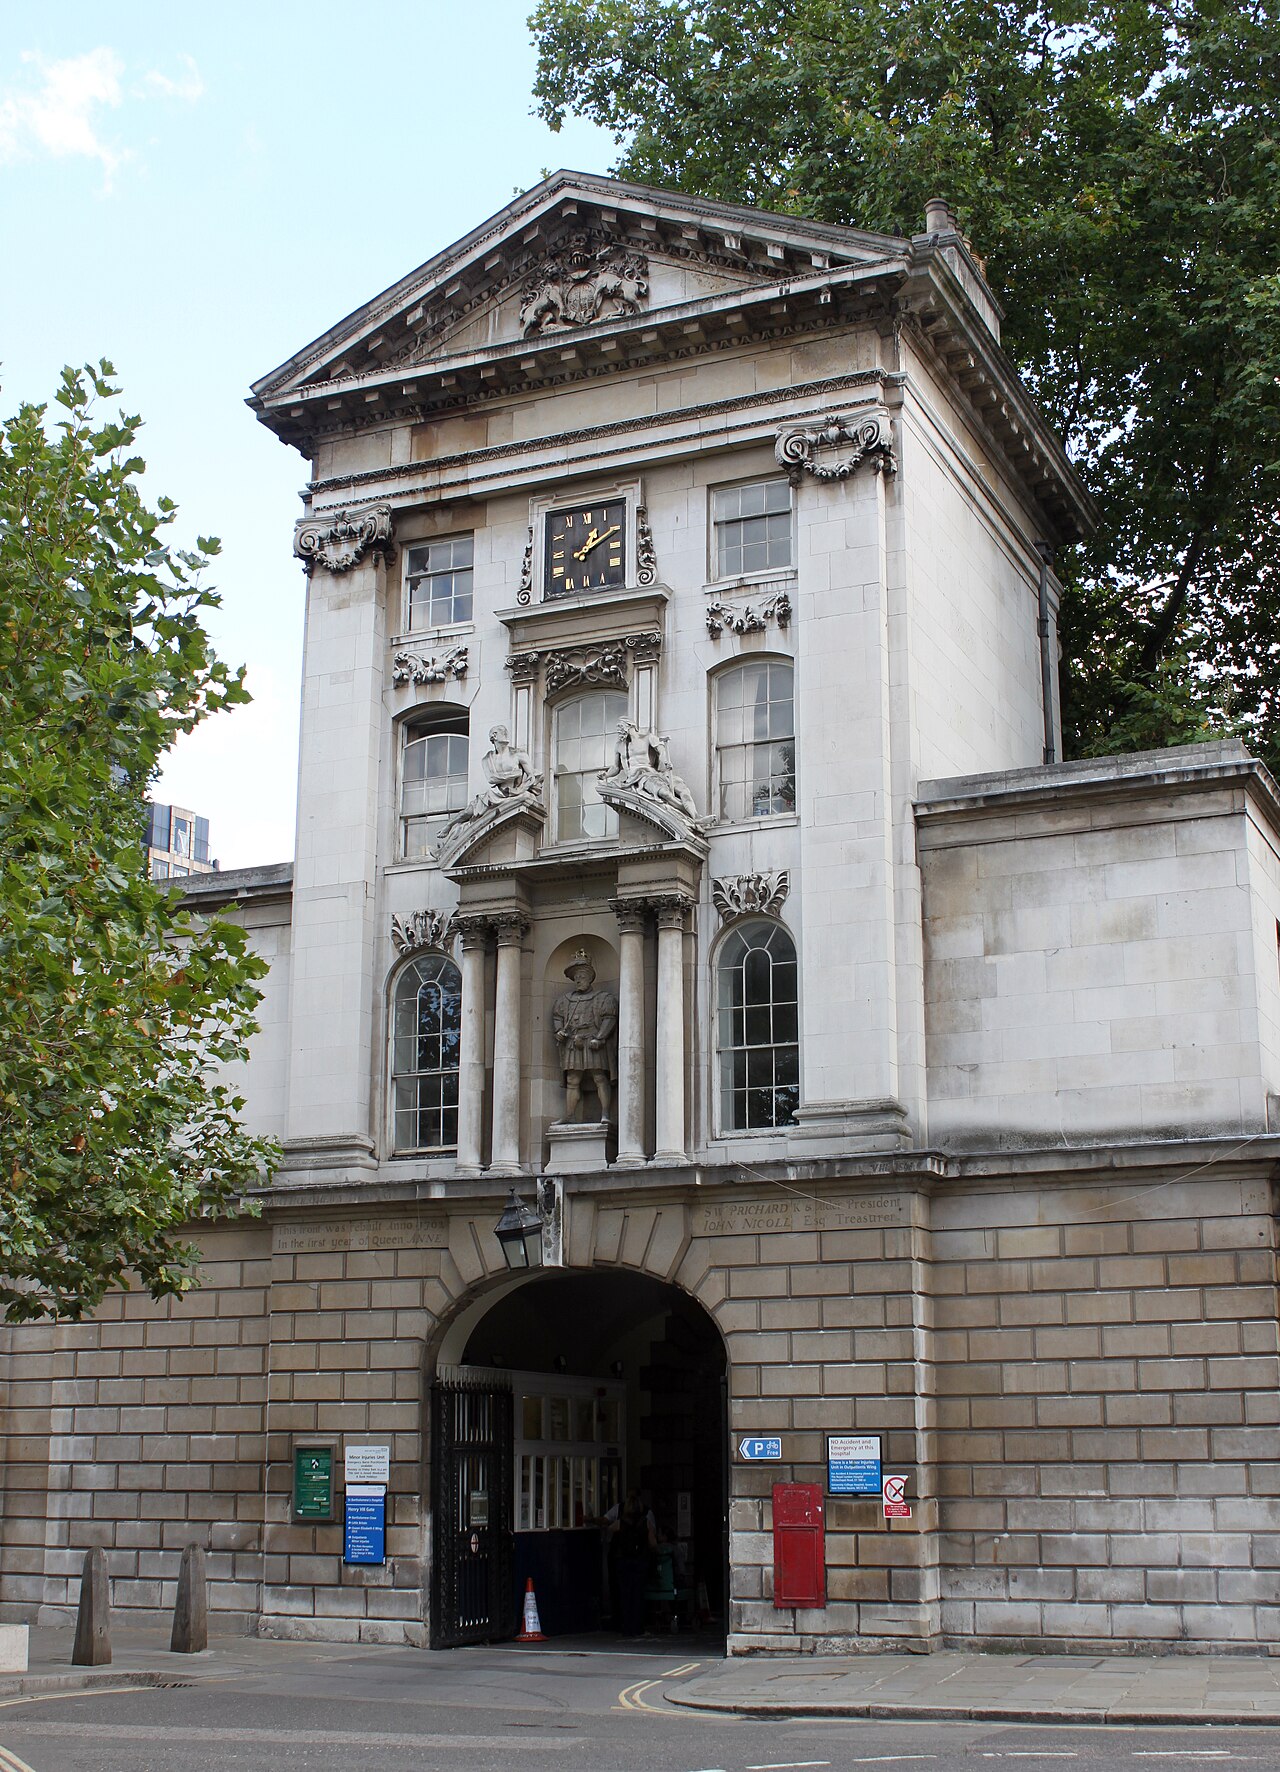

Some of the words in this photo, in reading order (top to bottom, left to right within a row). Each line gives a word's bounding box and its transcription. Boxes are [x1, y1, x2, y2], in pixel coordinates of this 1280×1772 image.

[730, 1203, 789, 1216] PRICHARD
[848, 1196, 900, 1209] President
[325, 1224, 346, 1234] was
[278, 1239, 288, 1249] In
[290, 1238, 304, 1248] the
[332, 1239, 352, 1250] year
[372, 1236, 404, 1248] Queen
[754, 1442, 764, 1455] P
